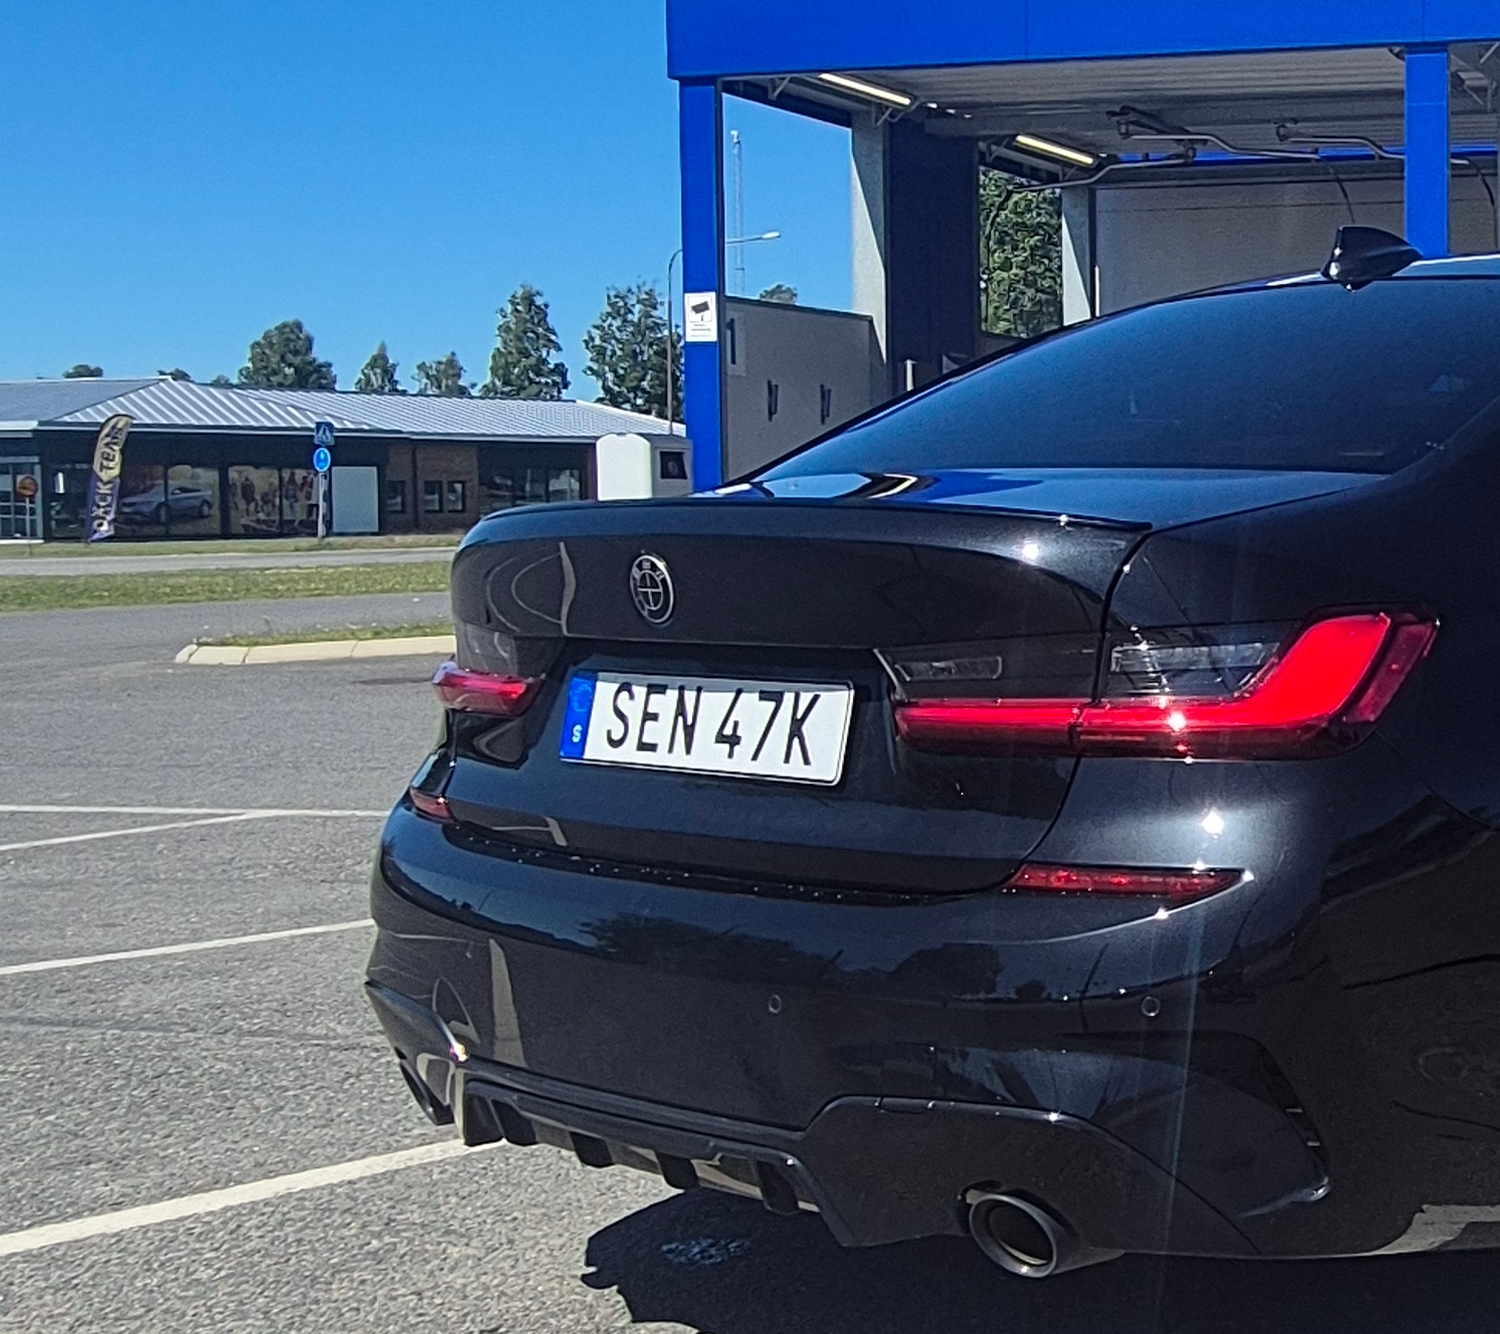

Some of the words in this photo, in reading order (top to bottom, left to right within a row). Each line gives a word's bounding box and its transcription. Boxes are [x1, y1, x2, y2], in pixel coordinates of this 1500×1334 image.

[571, 724, 583, 744] S
[606, 681, 703, 755] SEN
[714, 687, 821, 766] 47K
